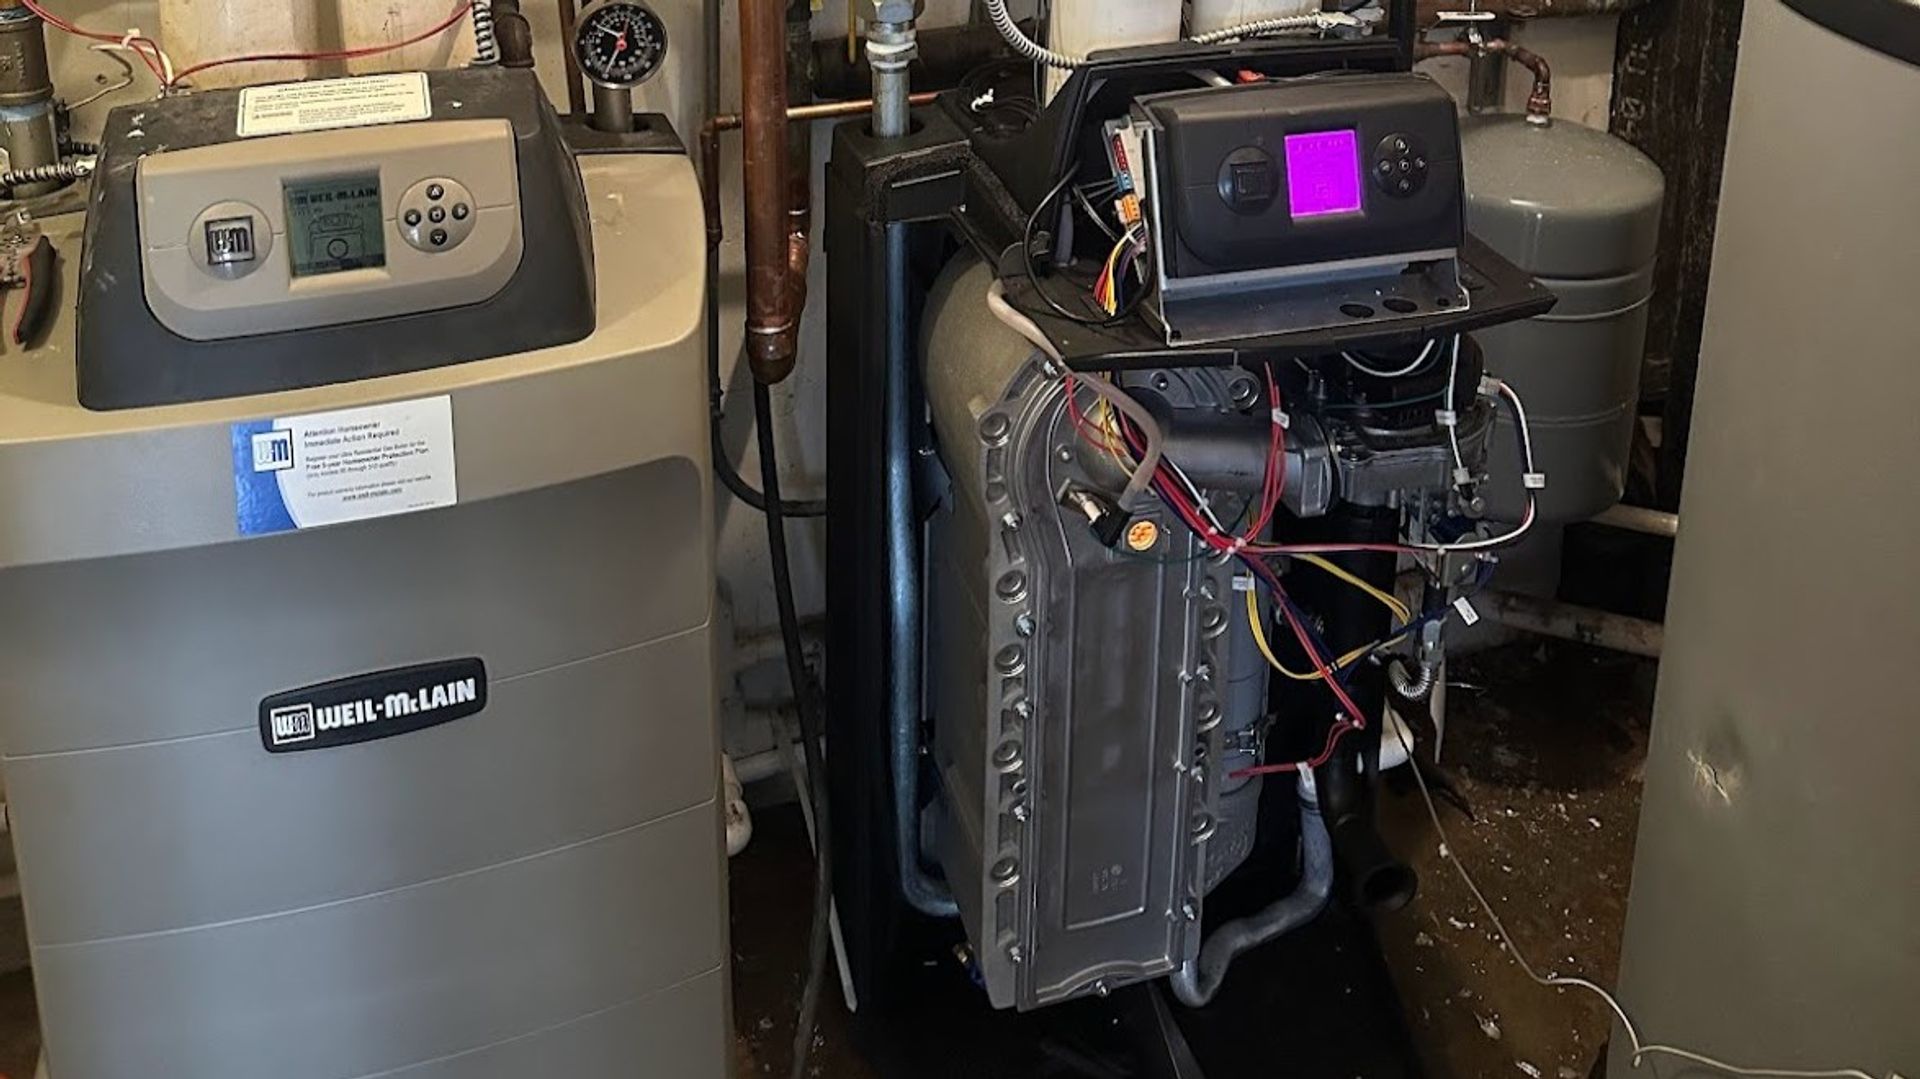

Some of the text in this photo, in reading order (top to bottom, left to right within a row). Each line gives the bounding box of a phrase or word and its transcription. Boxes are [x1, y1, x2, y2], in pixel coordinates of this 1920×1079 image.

[304, 422, 380, 438] Attention Homeowner
[304, 428, 400, 448] Immediate Action Required
[381, 450, 414, 460] Protection
[316, 677, 477, 731] WEIL-McLAIN
